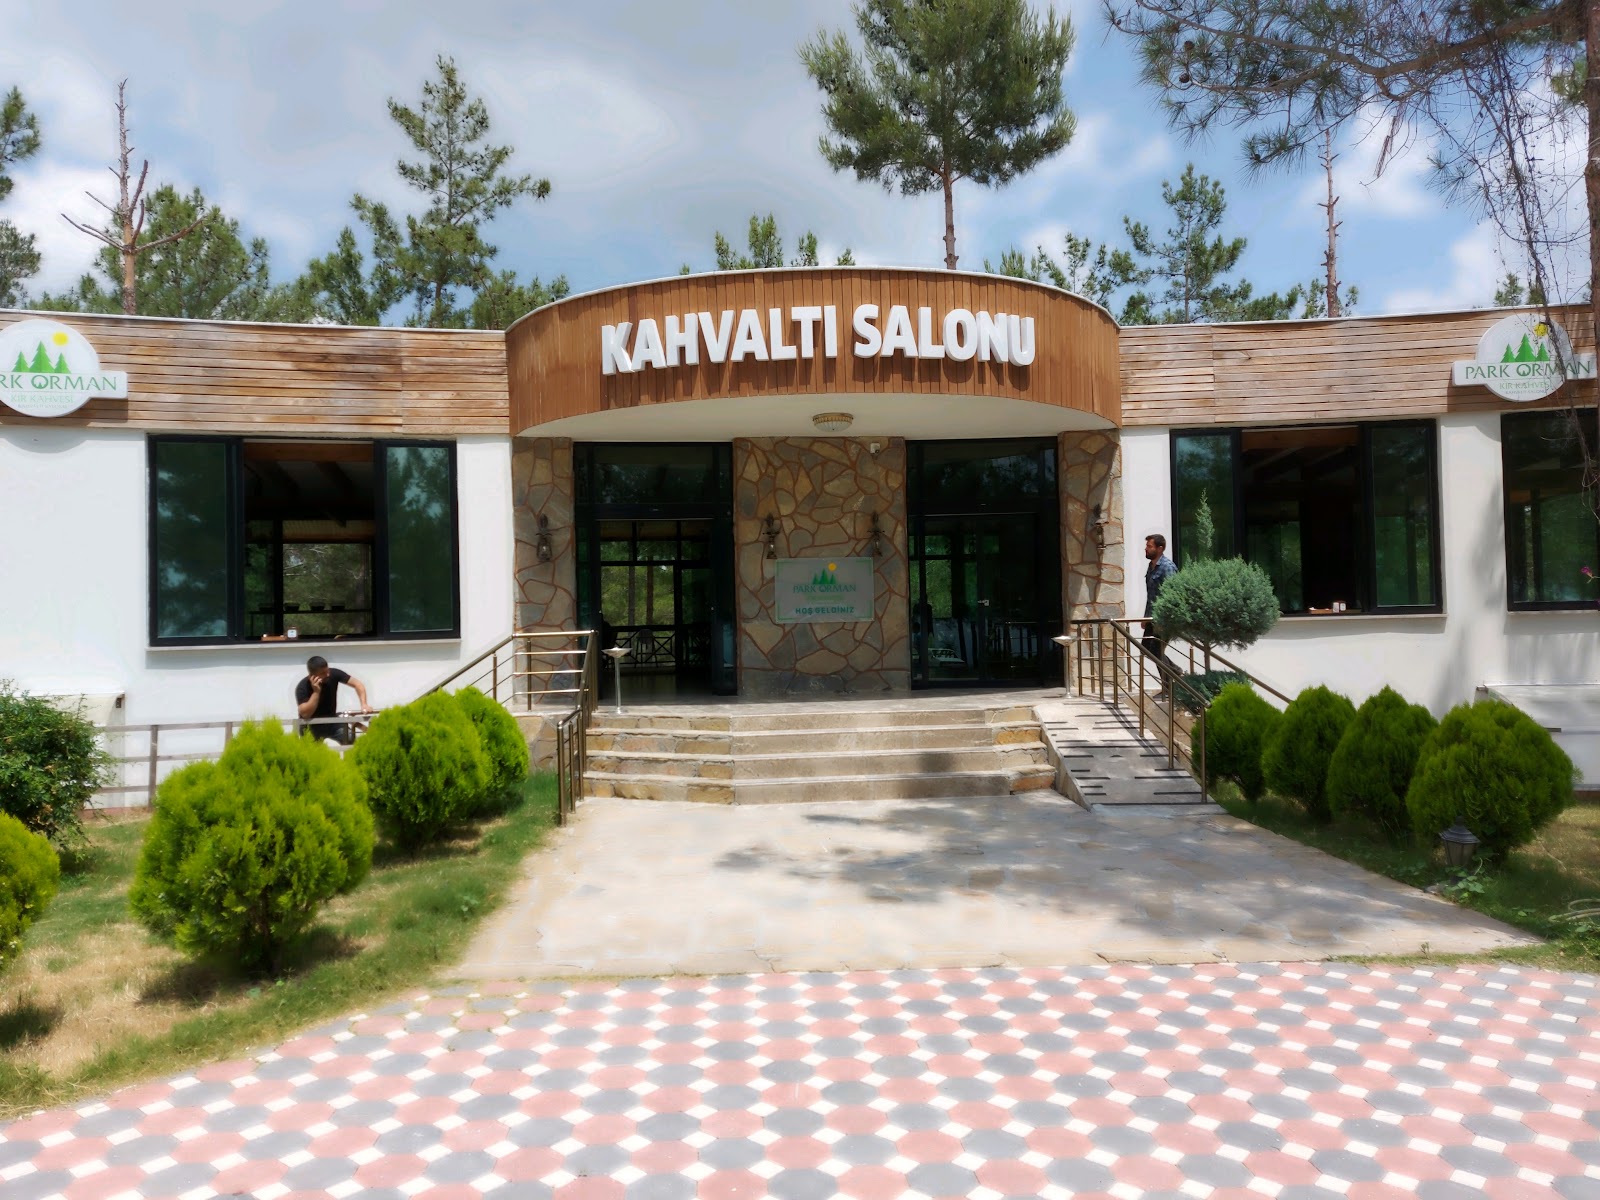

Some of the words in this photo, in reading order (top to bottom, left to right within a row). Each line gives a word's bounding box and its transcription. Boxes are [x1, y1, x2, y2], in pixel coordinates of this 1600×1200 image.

[602, 305, 838, 376] KAHVALTI
[852, 304, 1036, 367] SALONU
[1465, 364, 1510, 379] PARK
[1516, 360, 1591, 377] ORMAN
[31, 375, 117, 391] ORMAN
[793, 585, 816, 593] PARK
[818, 584, 856, 593] ORMAN
[795, 607, 813, 615] HOŞ
